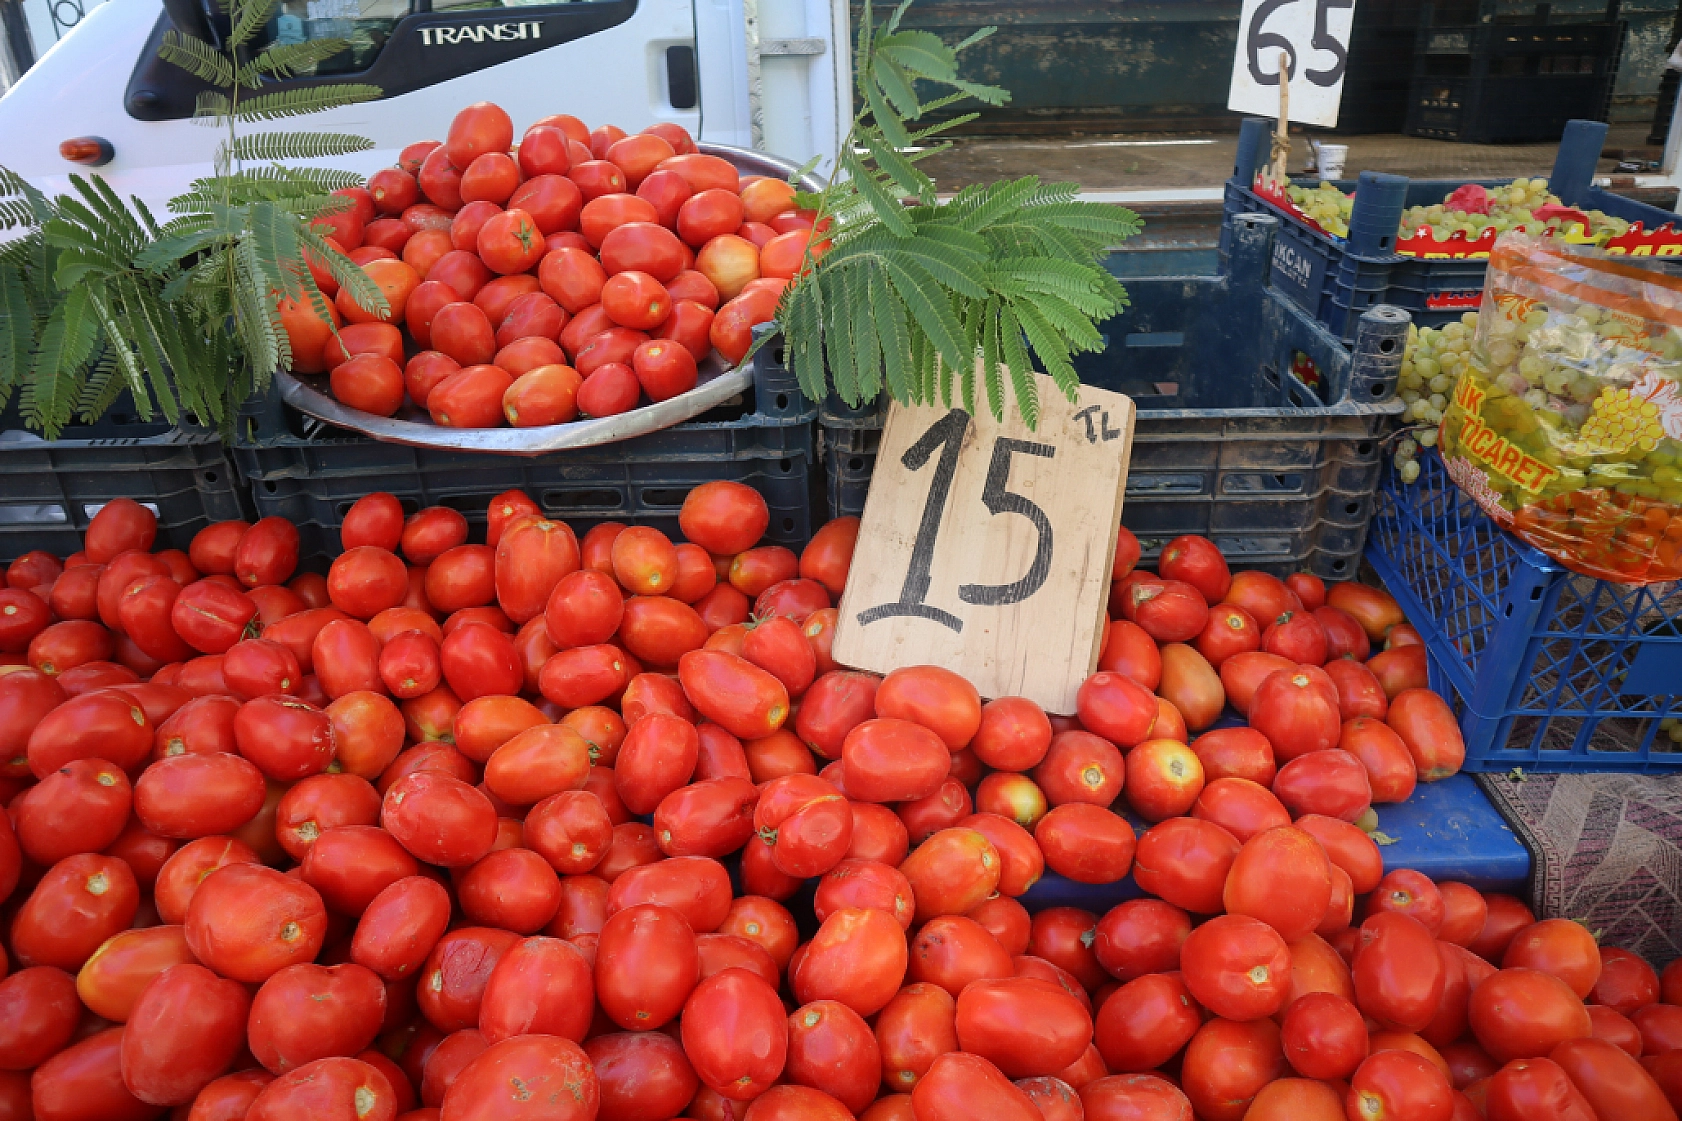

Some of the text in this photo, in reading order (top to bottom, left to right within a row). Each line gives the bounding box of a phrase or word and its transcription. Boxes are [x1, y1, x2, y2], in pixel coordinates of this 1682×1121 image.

[417, 21, 544, 45] TRANSIT
[1247, 0, 1352, 87] 65
[1460, 414, 1554, 490] TİCARET
[856, 405, 1121, 634] 15 TL
